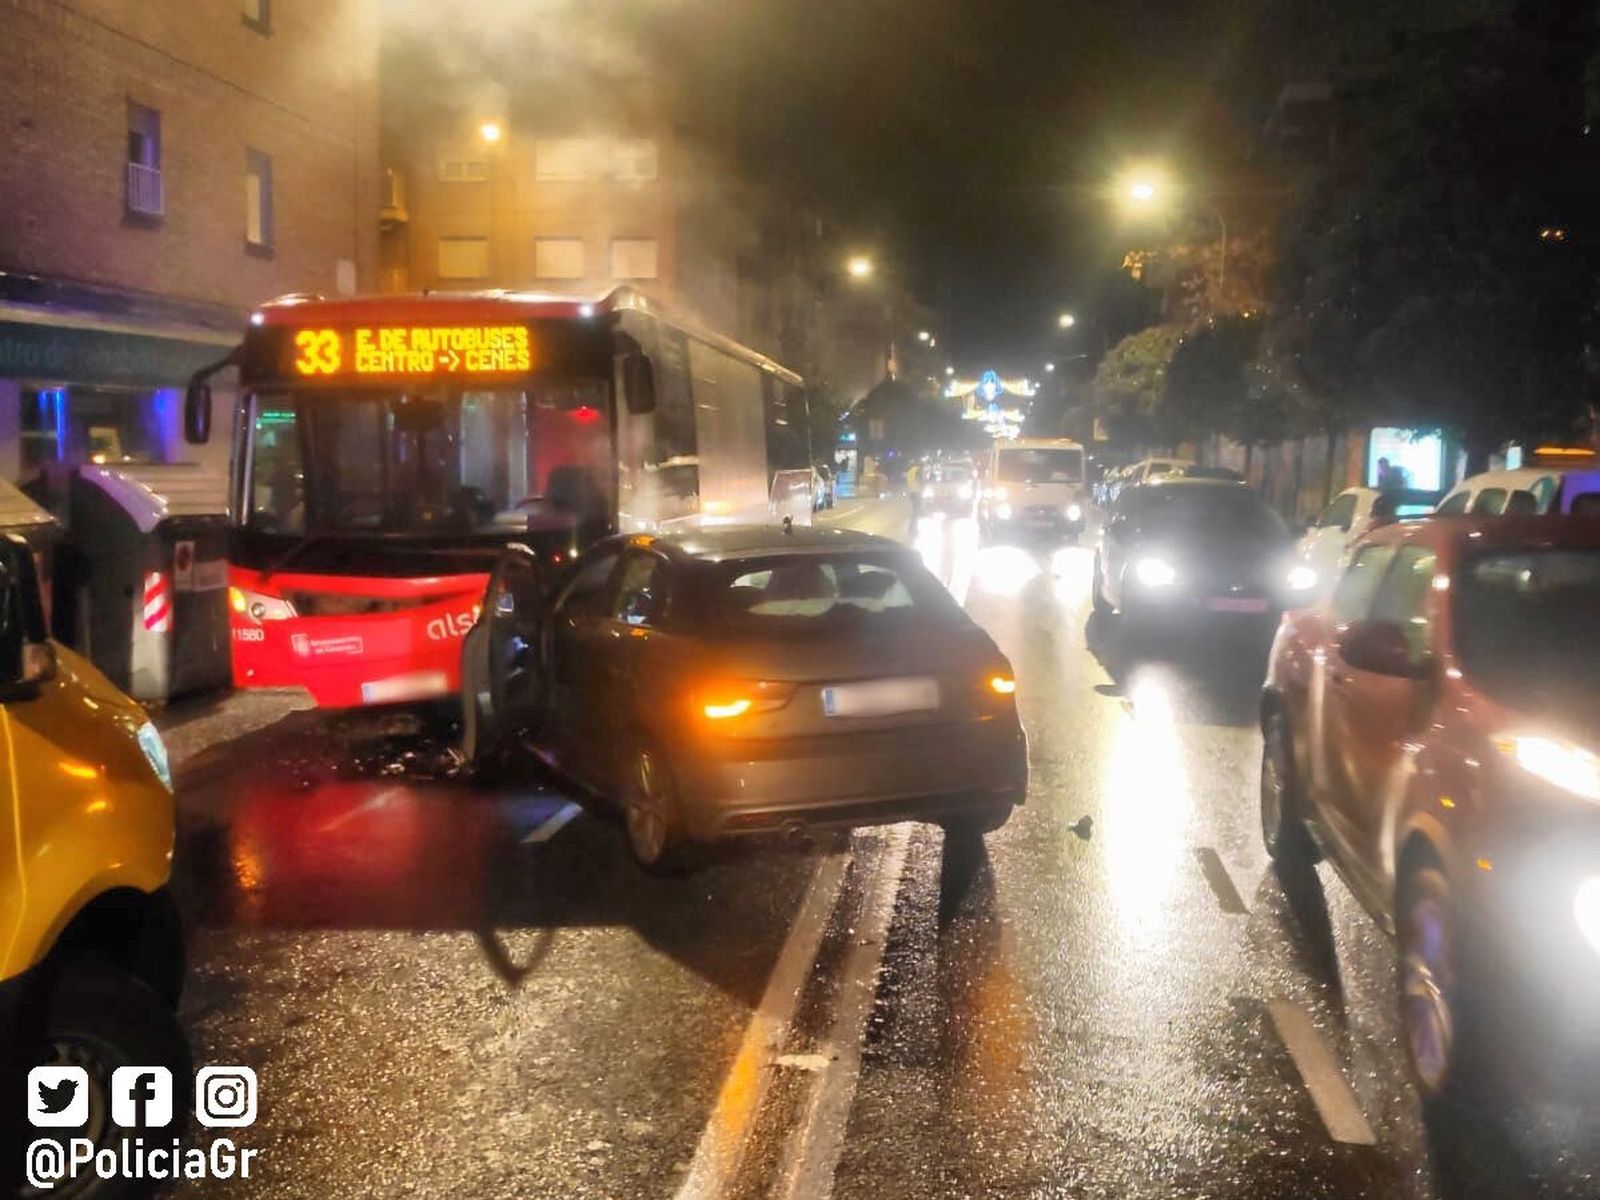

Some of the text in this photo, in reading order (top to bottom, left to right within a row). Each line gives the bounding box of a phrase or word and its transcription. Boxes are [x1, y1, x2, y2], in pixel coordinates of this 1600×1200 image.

[356, 326, 528, 350] E. DE AUTOBUSES
[295, 330, 340, 374] 33
[356, 349, 530, 372] CENTRO CENES
[427, 609, 479, 640] als
